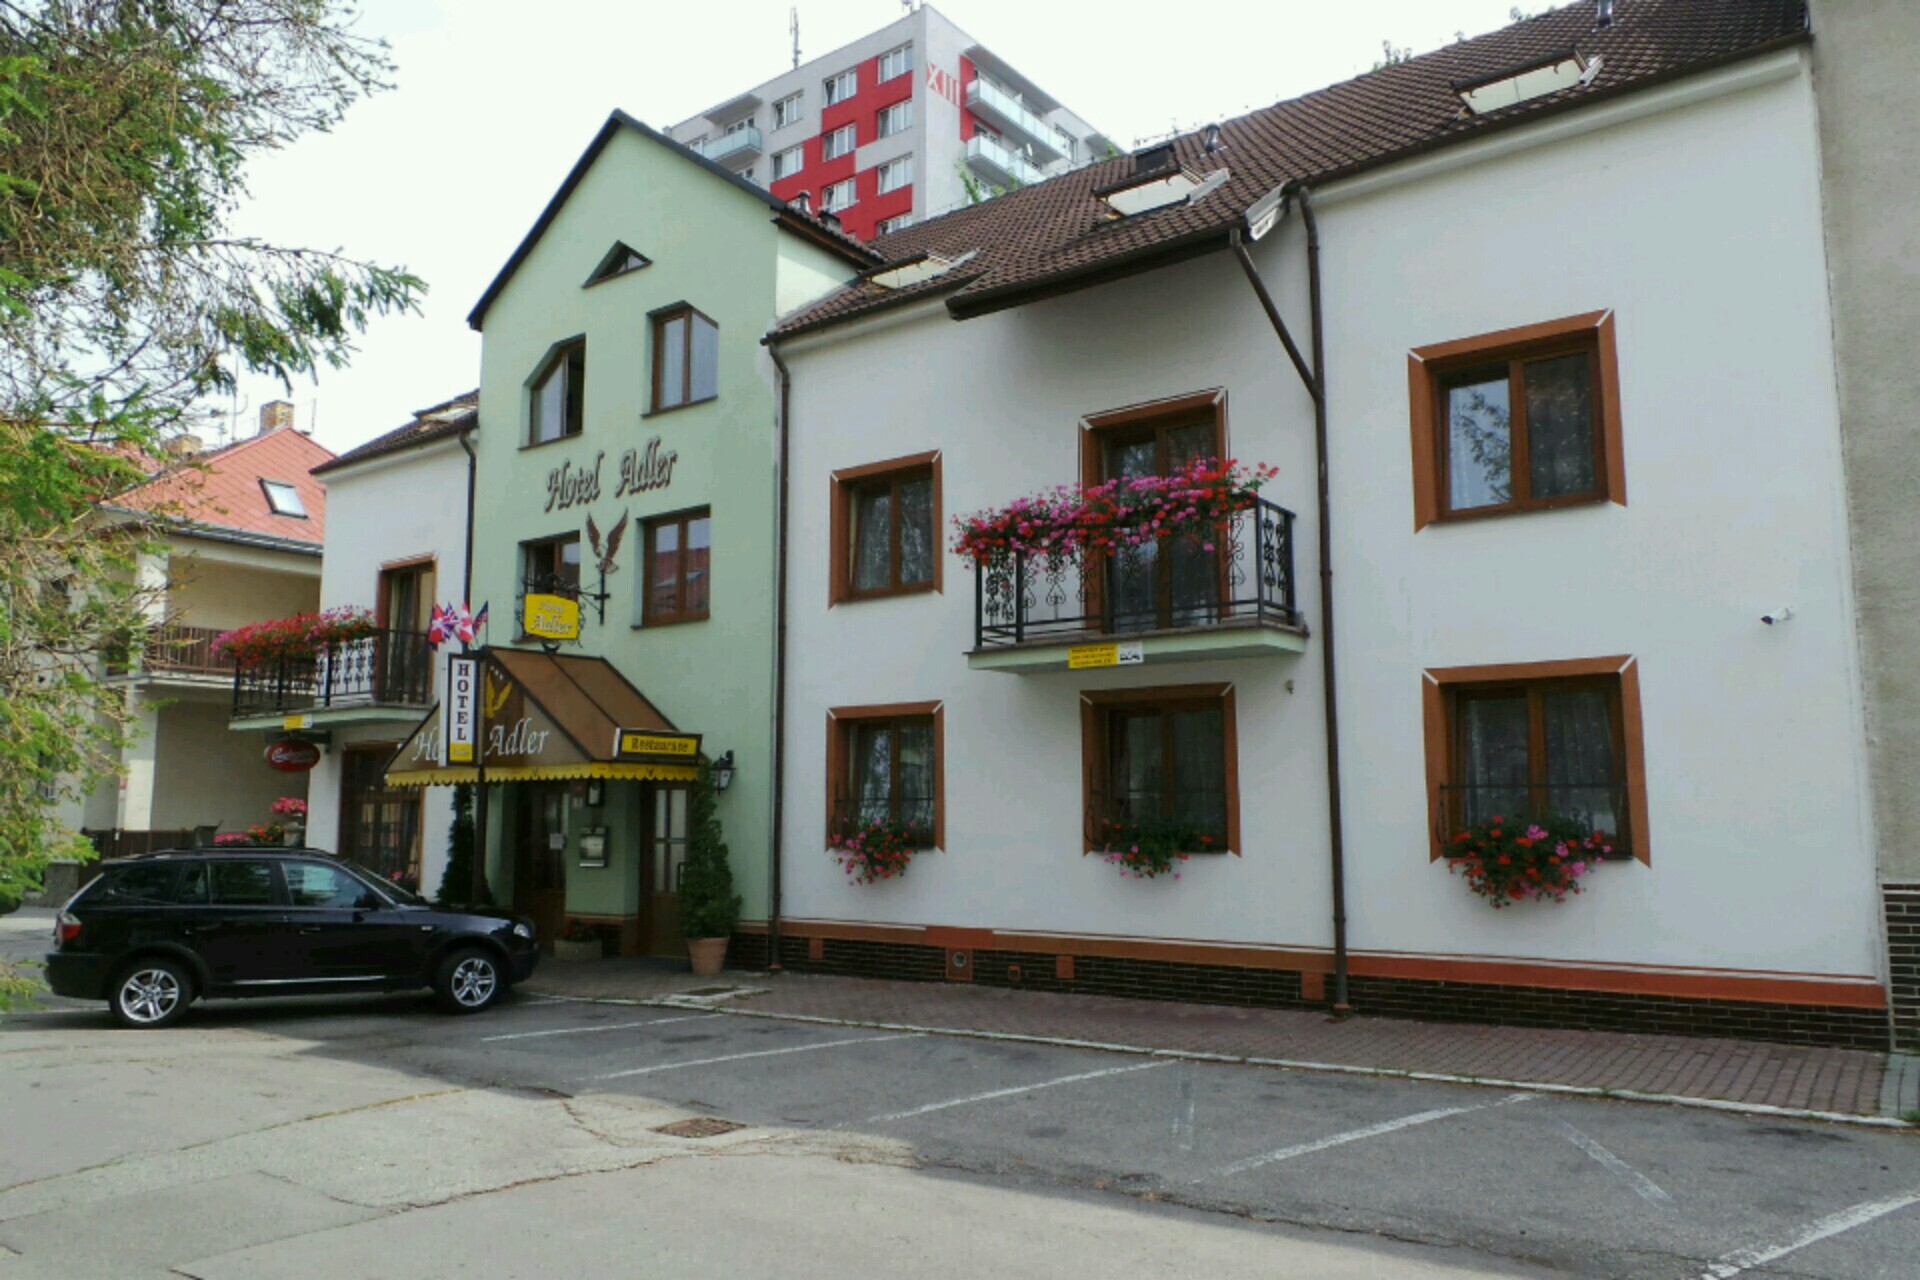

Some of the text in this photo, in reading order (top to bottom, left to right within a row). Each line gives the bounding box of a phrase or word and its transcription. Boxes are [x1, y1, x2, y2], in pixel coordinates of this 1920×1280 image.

[544, 435, 678, 513] Hotel Adler
[530, 613, 574, 634] Adler
[456, 663, 471, 741] HOTEL
[484, 717, 550, 757] Adler
